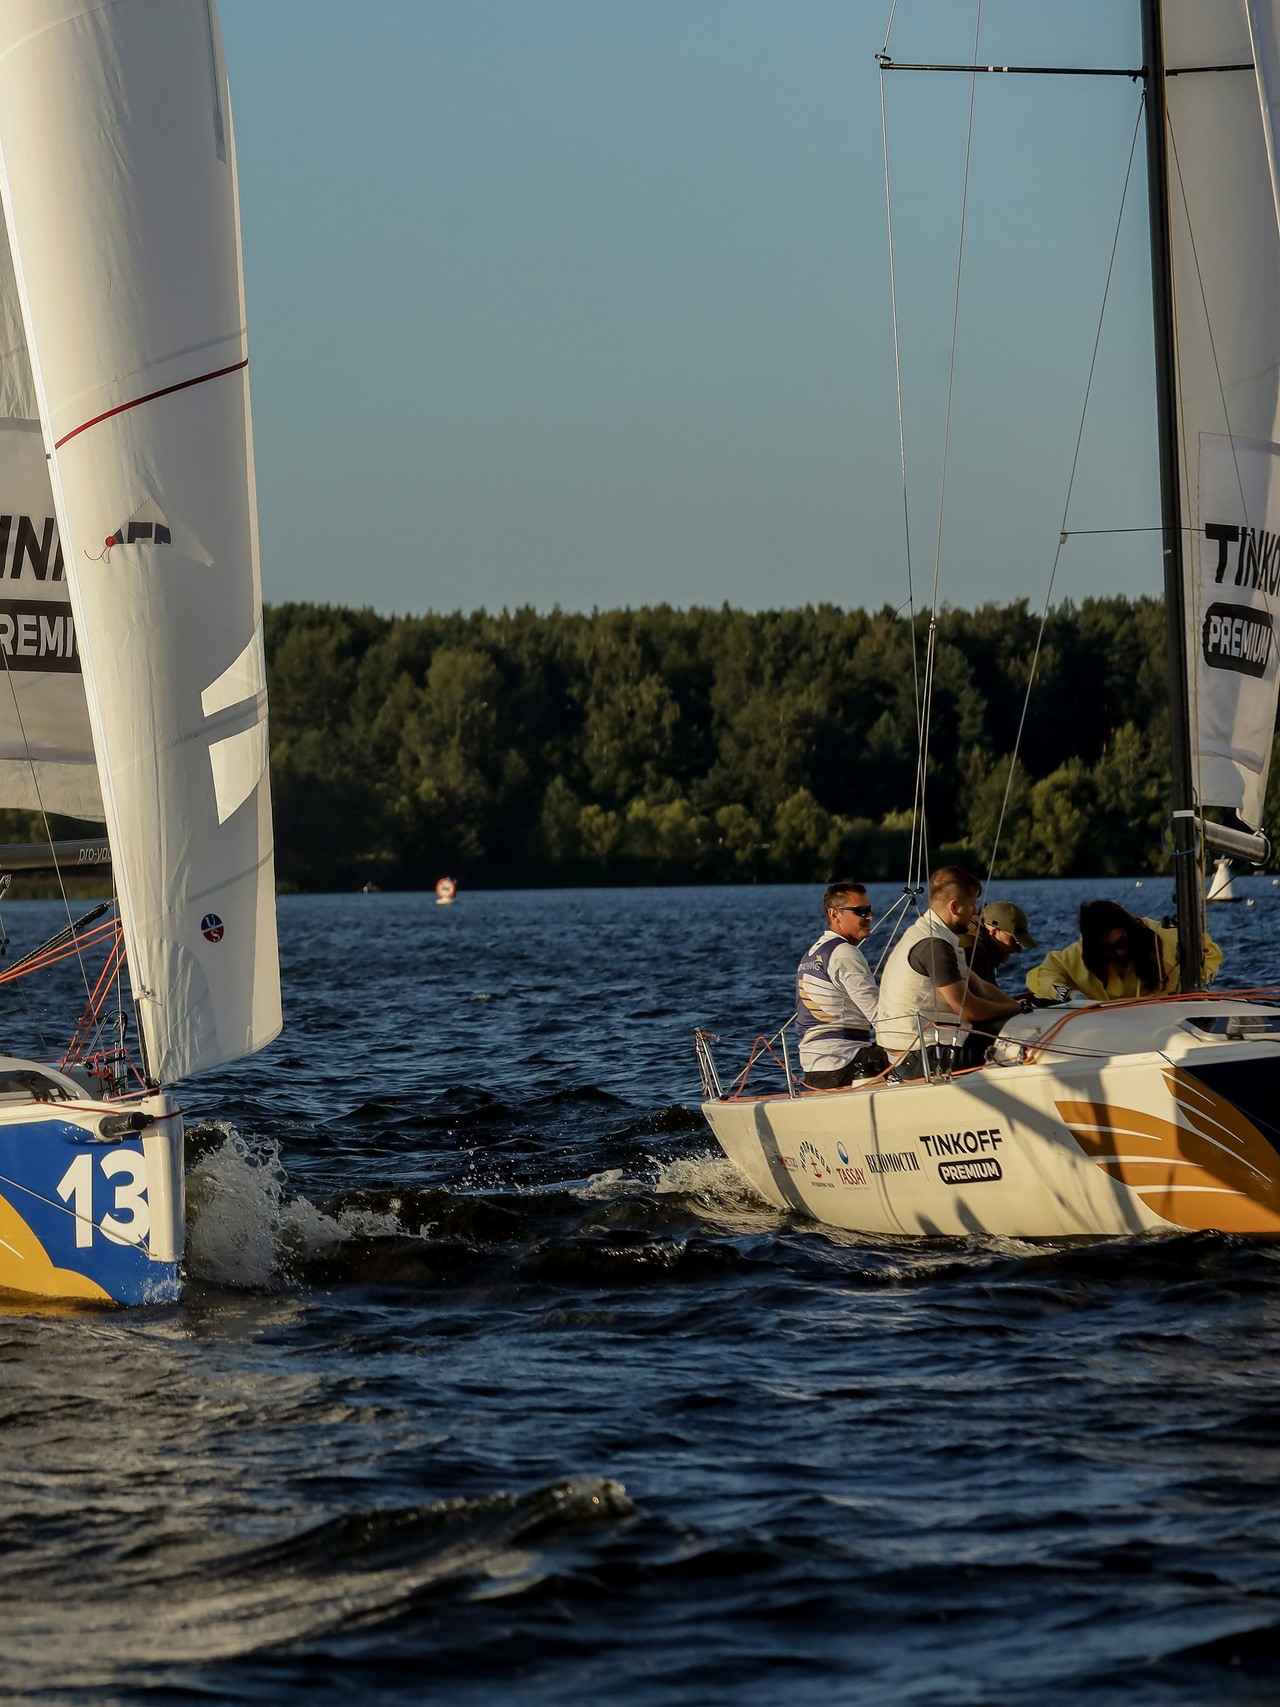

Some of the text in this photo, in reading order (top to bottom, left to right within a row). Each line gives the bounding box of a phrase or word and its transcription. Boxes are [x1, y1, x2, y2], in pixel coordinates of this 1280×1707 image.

[1205, 523, 1280, 597] TINKO
[1207, 615, 1271, 665] PREMIUM
[919, 1129, 1003, 1157] TINKOFF
[836, 1168, 868, 1186] TASSAY
[865, 1152, 921, 1174] ВЕДОМОСТИ
[940, 1161, 1000, 1182] PREMIUM
[56, 1148, 150, 1249] 13
